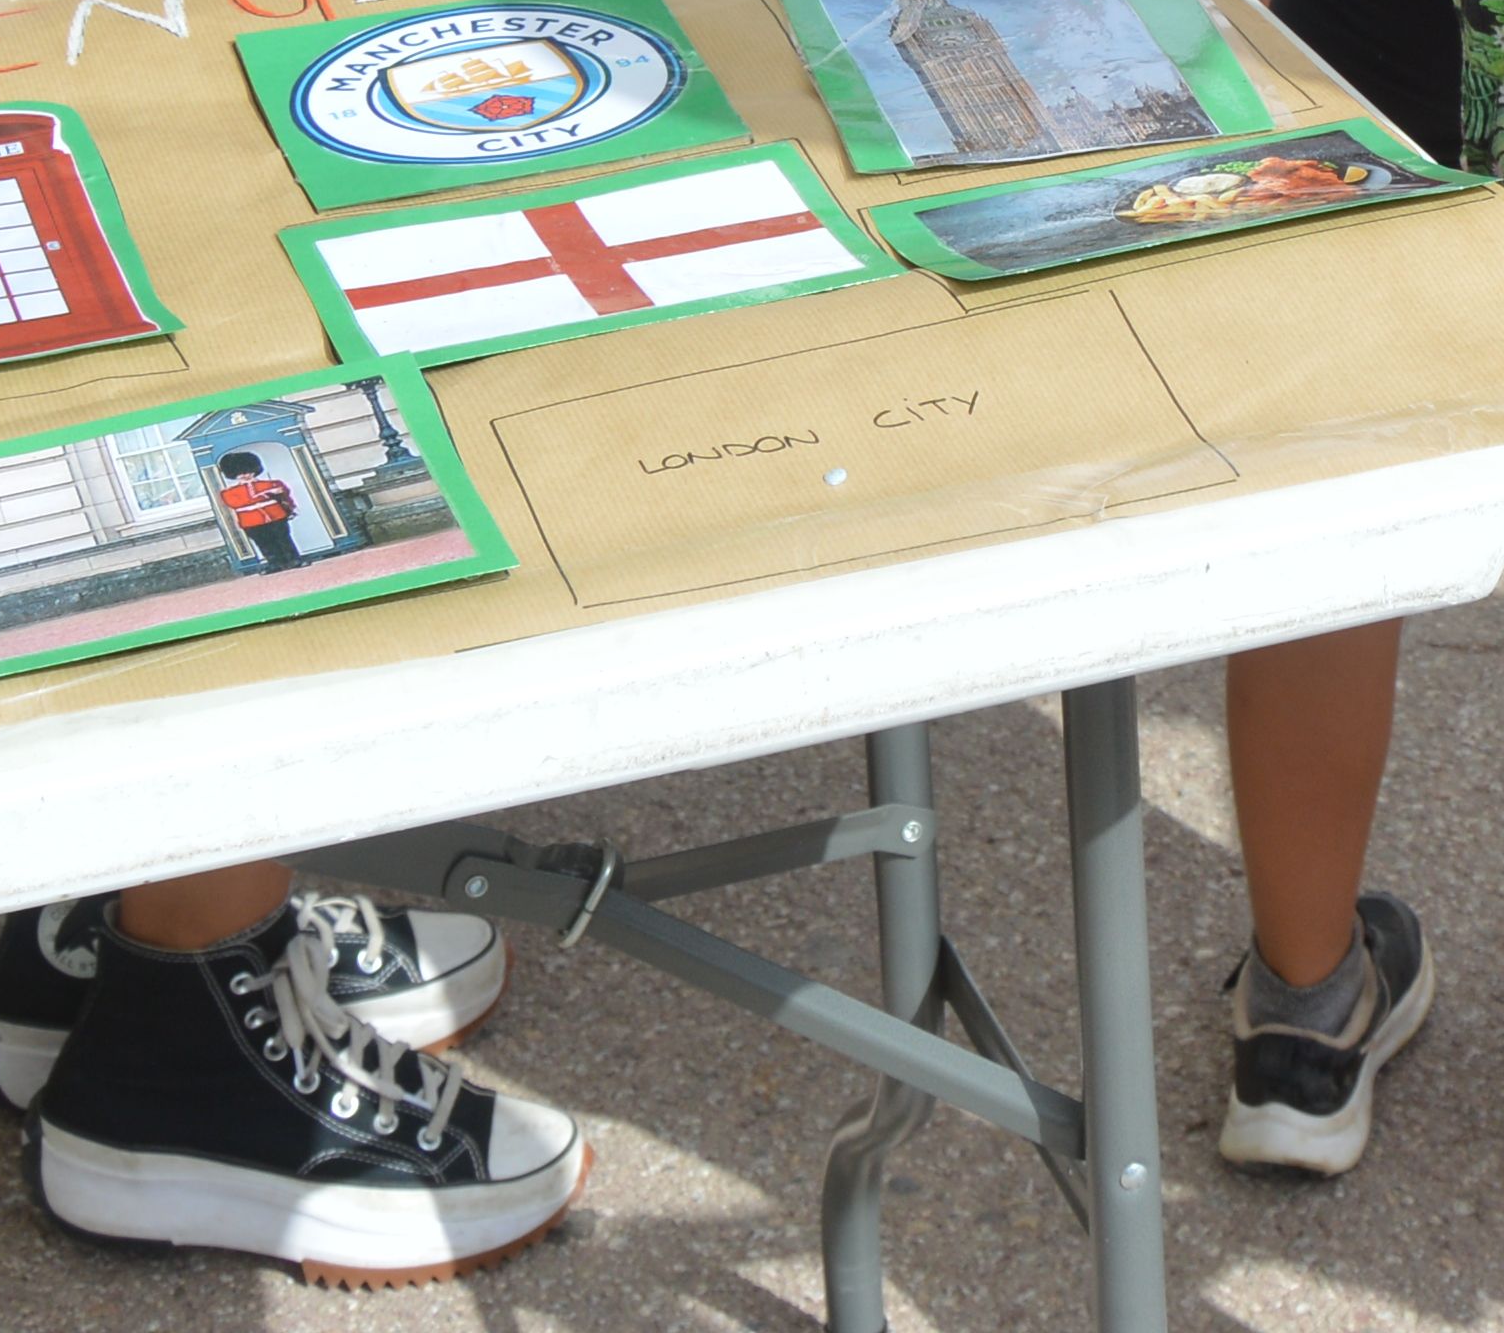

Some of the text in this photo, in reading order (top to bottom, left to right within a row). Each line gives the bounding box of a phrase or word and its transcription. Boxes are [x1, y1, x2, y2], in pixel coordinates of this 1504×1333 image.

[326, 17, 614, 92] MANCHESTER
[615, 54, 651, 68] 94
[477, 122, 583, 154] CITY
[638, 429, 820, 475] LONDON
